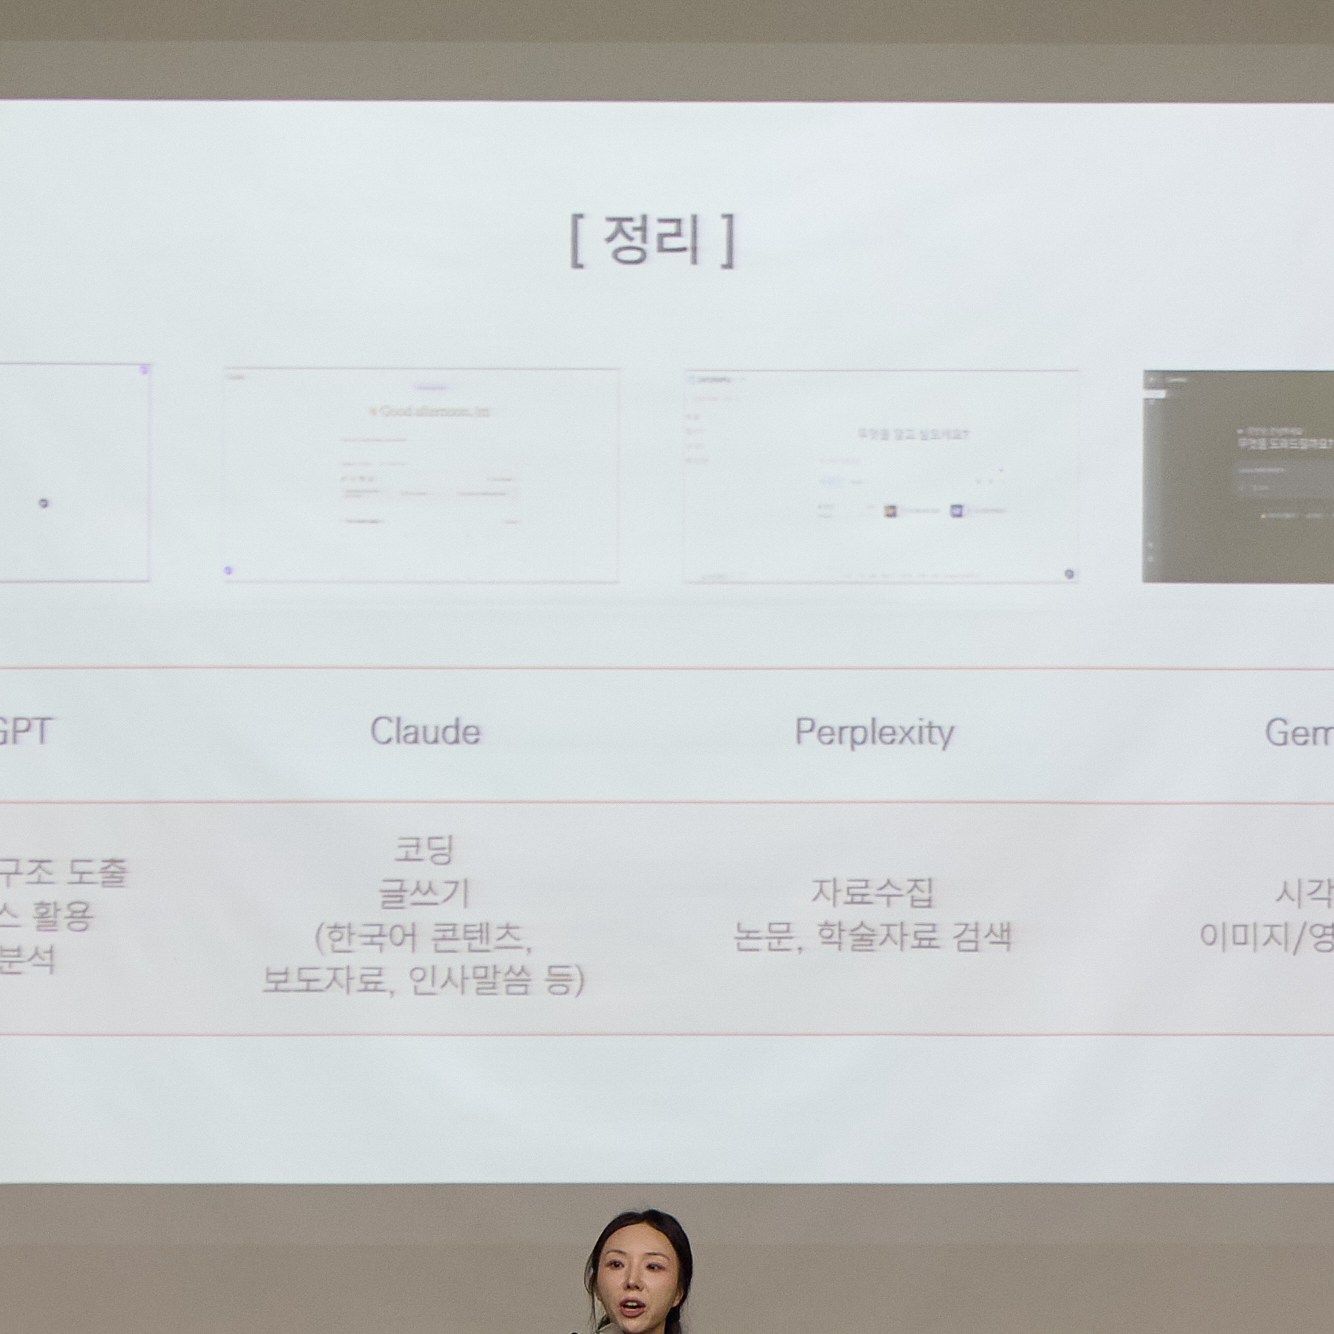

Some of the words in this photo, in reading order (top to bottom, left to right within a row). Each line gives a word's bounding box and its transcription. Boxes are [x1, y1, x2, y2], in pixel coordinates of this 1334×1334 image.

[603, 213, 699, 266] 정리
[370, 715, 481, 746] Claude
[795, 716, 956, 752] Perplexity
[394, 834, 454, 866] 코딩
[67, 857, 129, 889] 도출
[378, 877, 470, 910] 글쓰기
[811, 877, 935, 909] 자료수집
[32, 900, 95, 933] 활용
[315, 921, 417, 956] (한국어
[430, 921, 532, 955] 콘텐츠,
[733, 921, 804, 955] 논문,
[817, 920, 941, 953] 학술자료
[952, 920, 1013, 953] 검색
[262, 964, 396, 998] 보도자료,
[409, 964, 533, 997] 인사말씀
[544, 964, 586, 999] 등)
